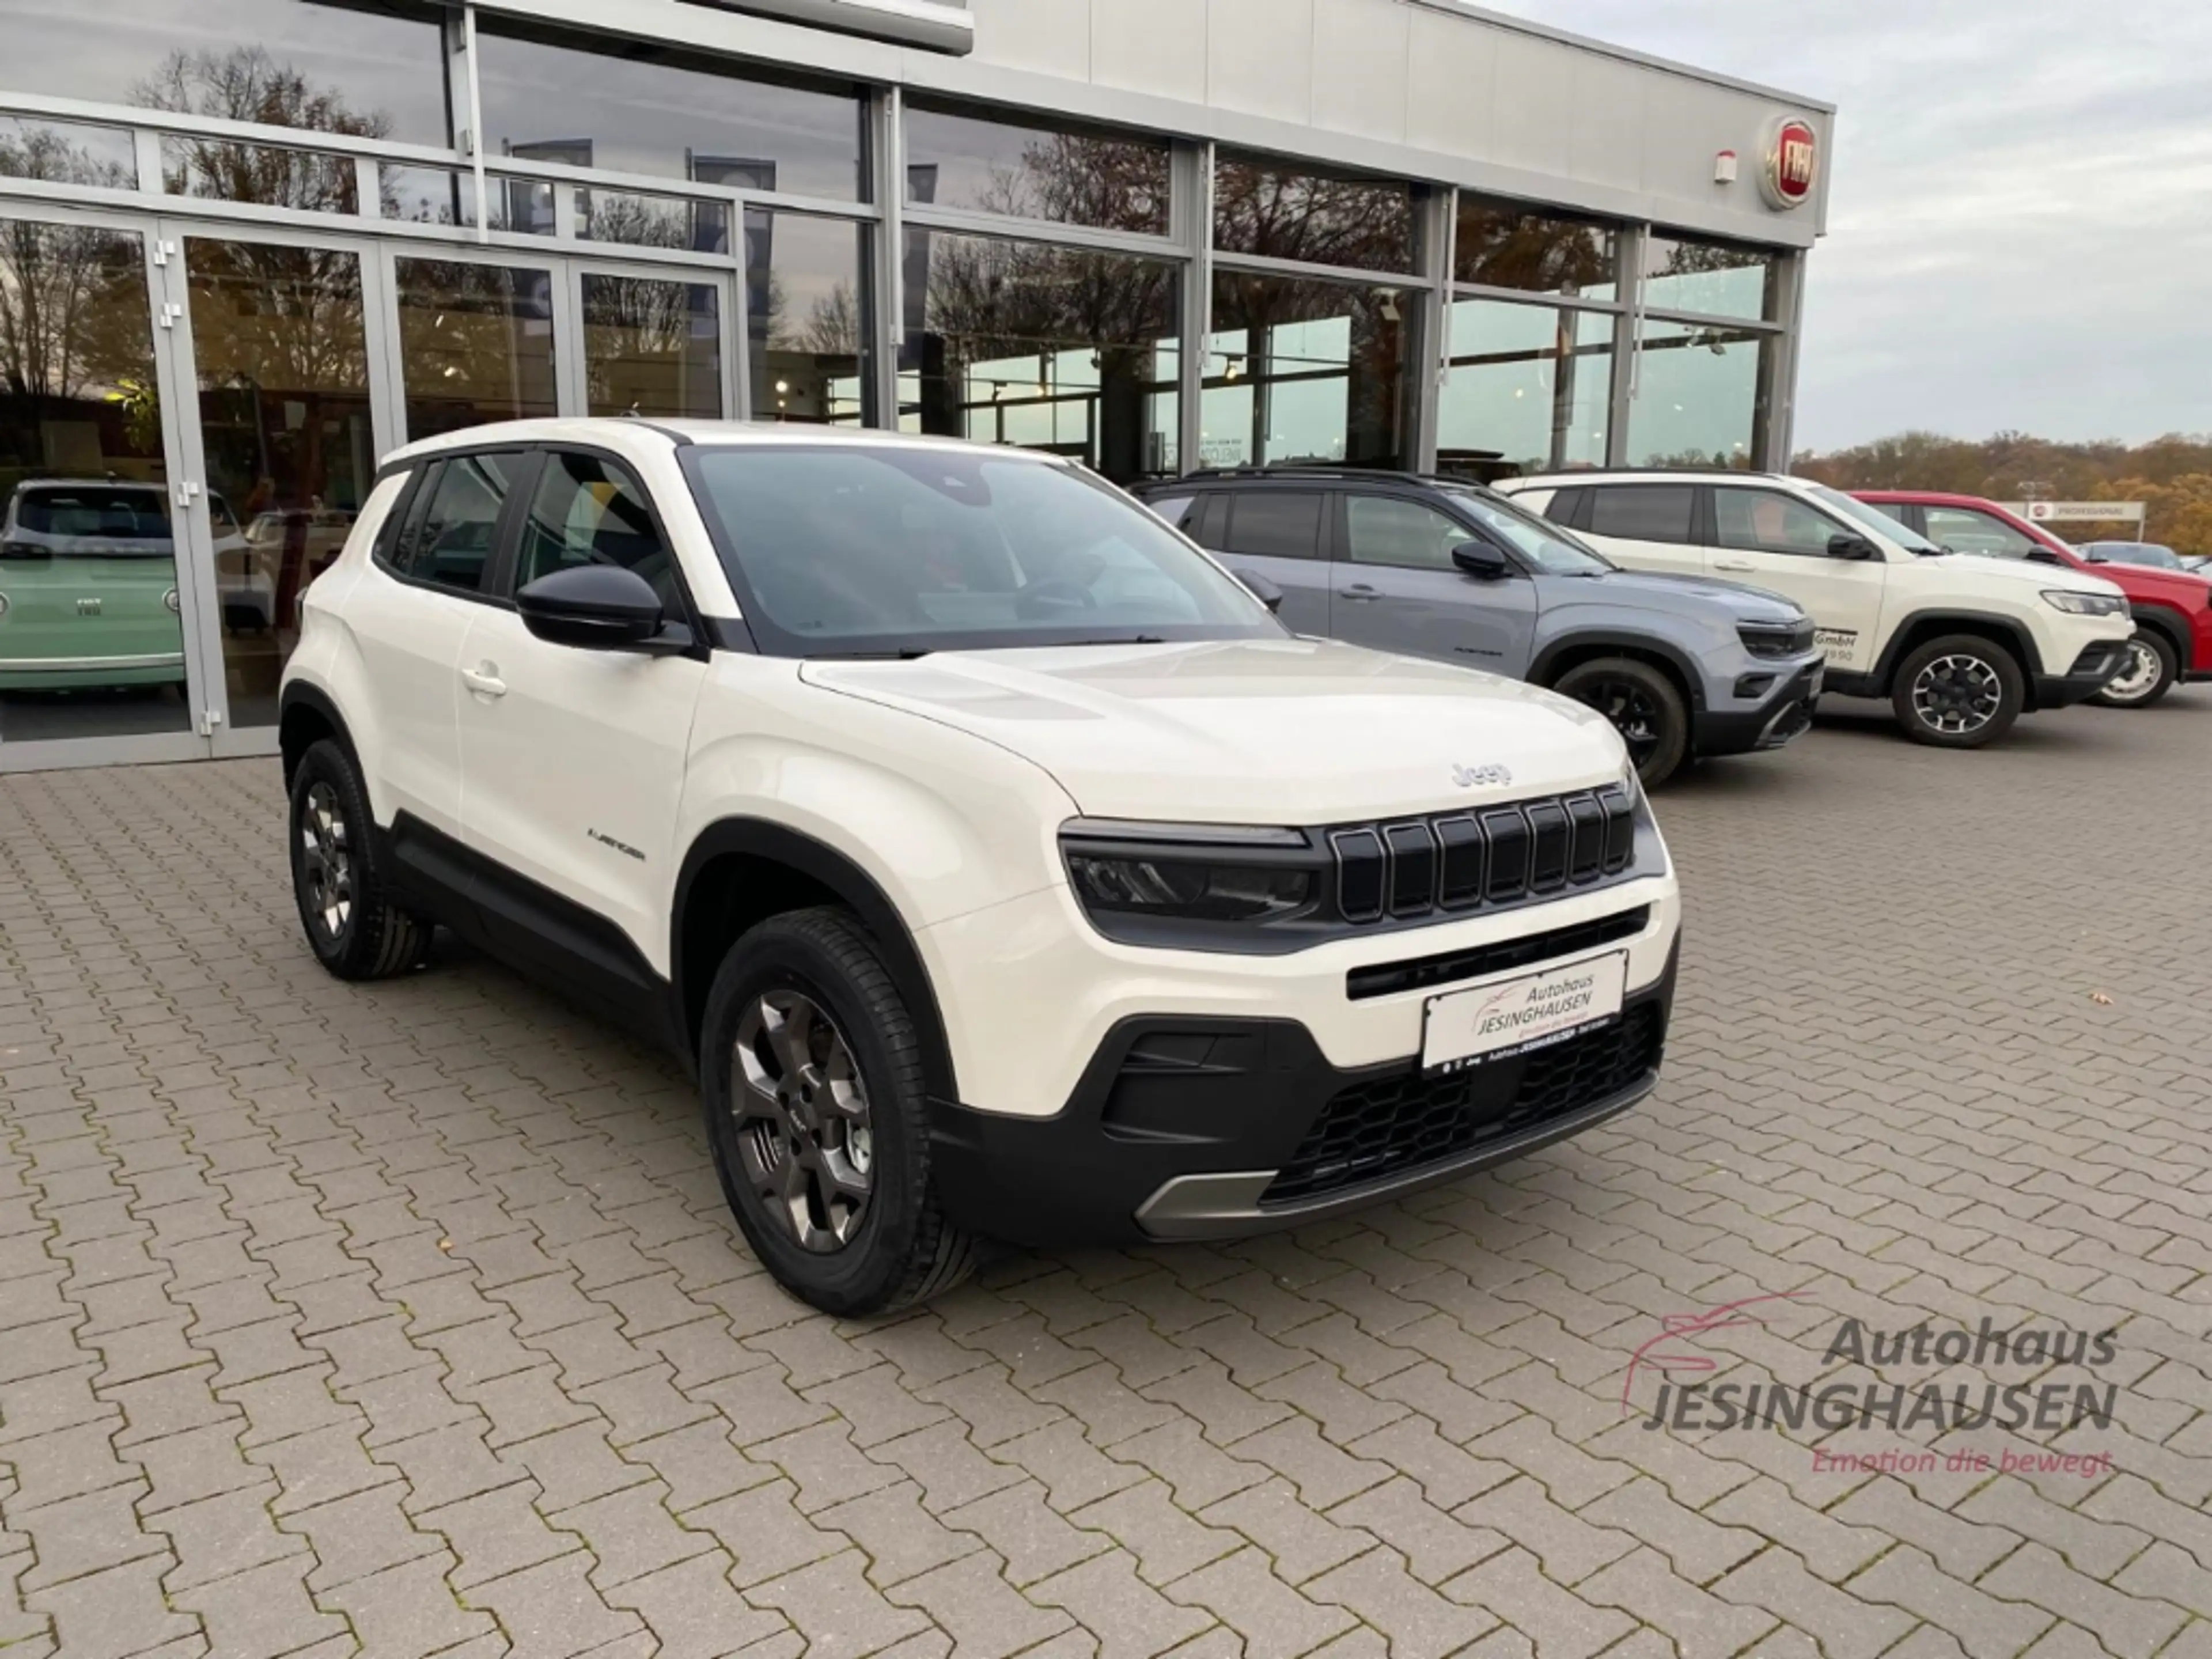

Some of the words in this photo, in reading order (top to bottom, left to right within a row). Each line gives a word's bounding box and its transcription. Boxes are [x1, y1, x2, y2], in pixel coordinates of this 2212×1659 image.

[1452, 763, 1512, 787] Jeep
[1525, 974, 1594, 1003] Autohaus
[1478, 991, 1593, 1036] JESINGHAUSEN
